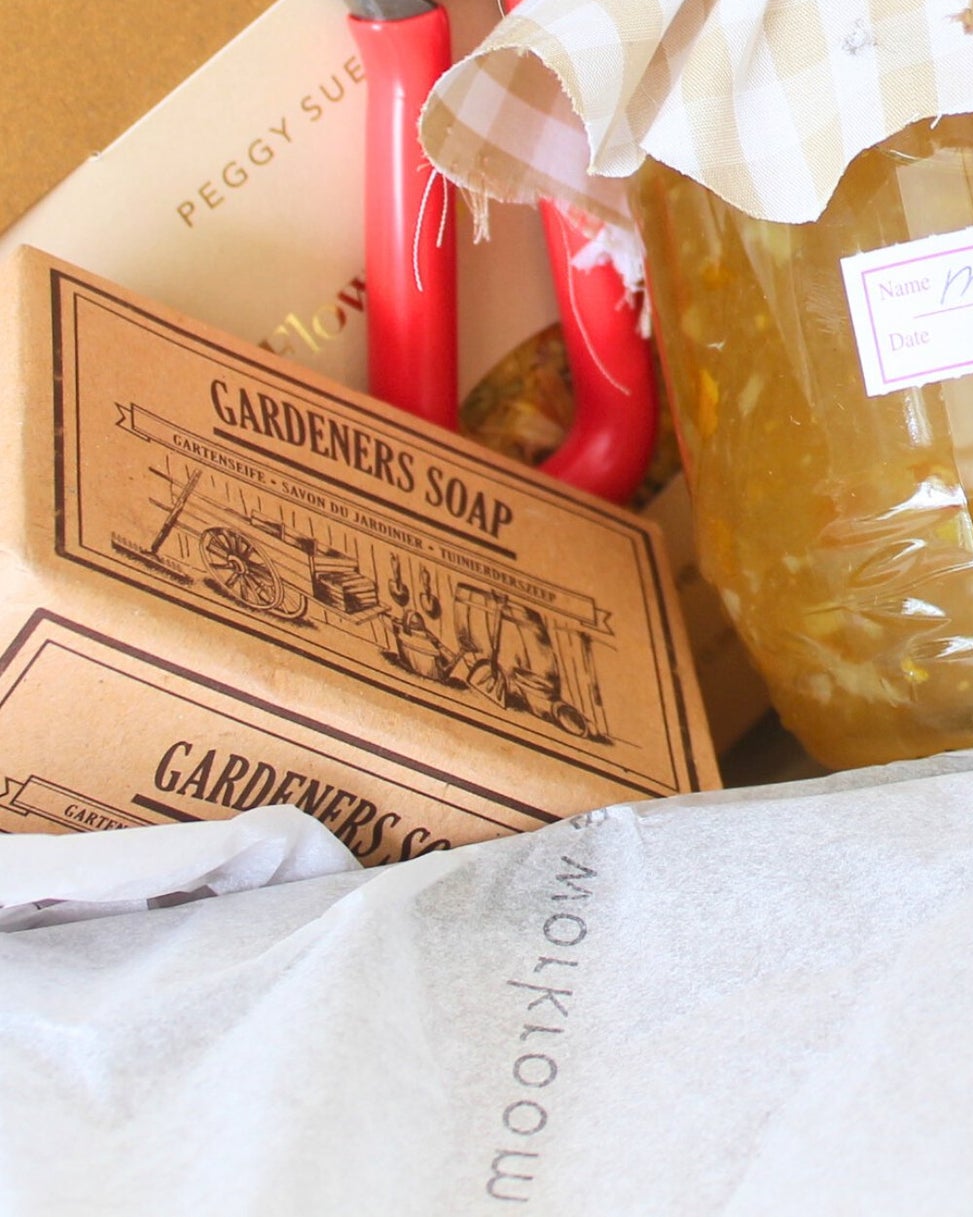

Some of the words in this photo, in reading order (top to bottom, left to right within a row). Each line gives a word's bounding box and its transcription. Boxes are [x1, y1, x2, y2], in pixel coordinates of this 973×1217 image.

[176, 117, 293, 228] PEGGY
[301, 56, 366, 122] SUE
[879, 274, 930, 301] Name
[888, 329, 930, 352] Date
[173, 434, 266, 484] GARTENSEIFE
[281, 482, 325, 508] SAVON
[330, 502, 349, 518] DU
[353, 511, 423, 551] JARDINIER
[210, 379, 415, 493] GARDENERS
[425, 466, 514, 539] SOAP
